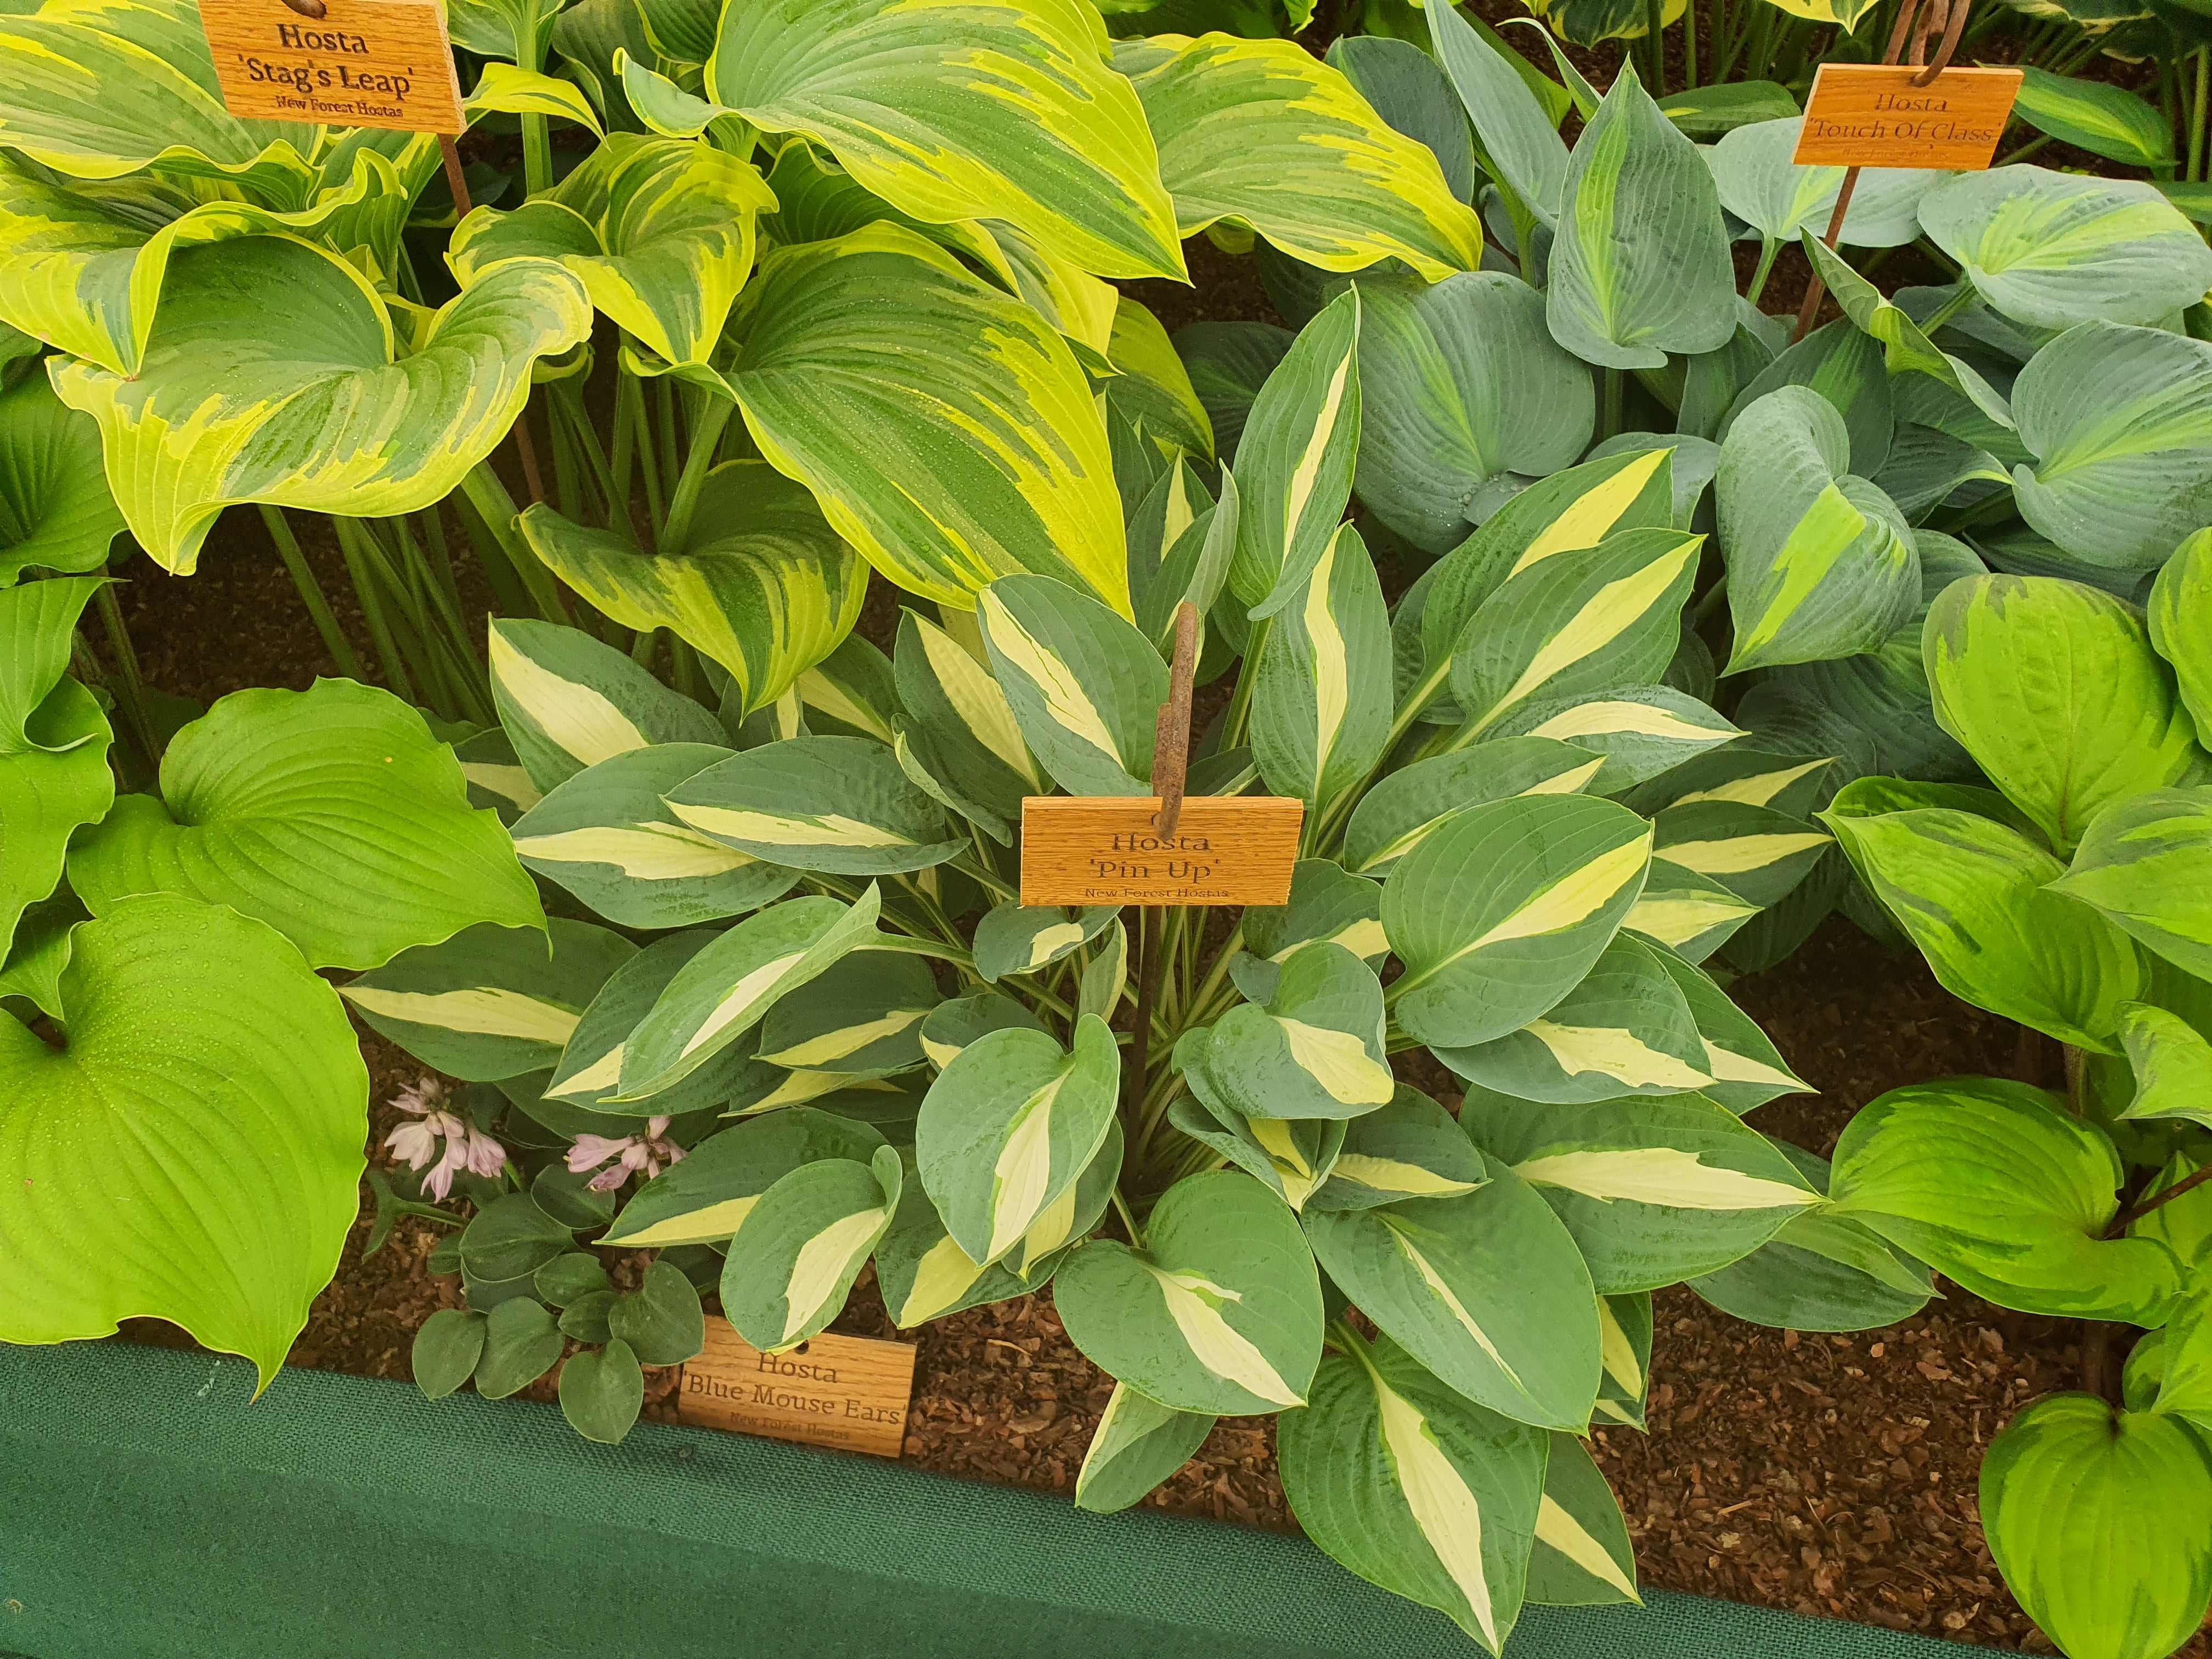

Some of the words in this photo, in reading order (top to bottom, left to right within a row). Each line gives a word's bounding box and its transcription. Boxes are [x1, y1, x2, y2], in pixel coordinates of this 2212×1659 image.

[276, 24, 369, 54] Hosta
[238, 54, 331, 94] 'Stag's
[336, 65, 414, 101] Leap'
[275, 95, 306, 110] New
[309, 98, 354, 114] Forest
[356, 101, 403, 117] Hostas
[1875, 94, 1948, 111] Hosta
[1810, 118, 1885, 139] 'Touch
[1894, 121, 1926, 140] Of
[1931, 122, 2002, 142] Class'
[1111, 833, 1211, 851] Hosta
[1085, 888, 1118, 898] New
[1124, 889, 1170, 898] Forest
[1177, 888, 1229, 898] Hostas
[757, 1352, 838, 1384] Hosta
[684, 1370, 744, 1401] 'Blue
[752, 1384, 836, 1414] Mouse
[844, 1399, 906, 1425] Ears'
[730, 1411, 759, 1425] New
